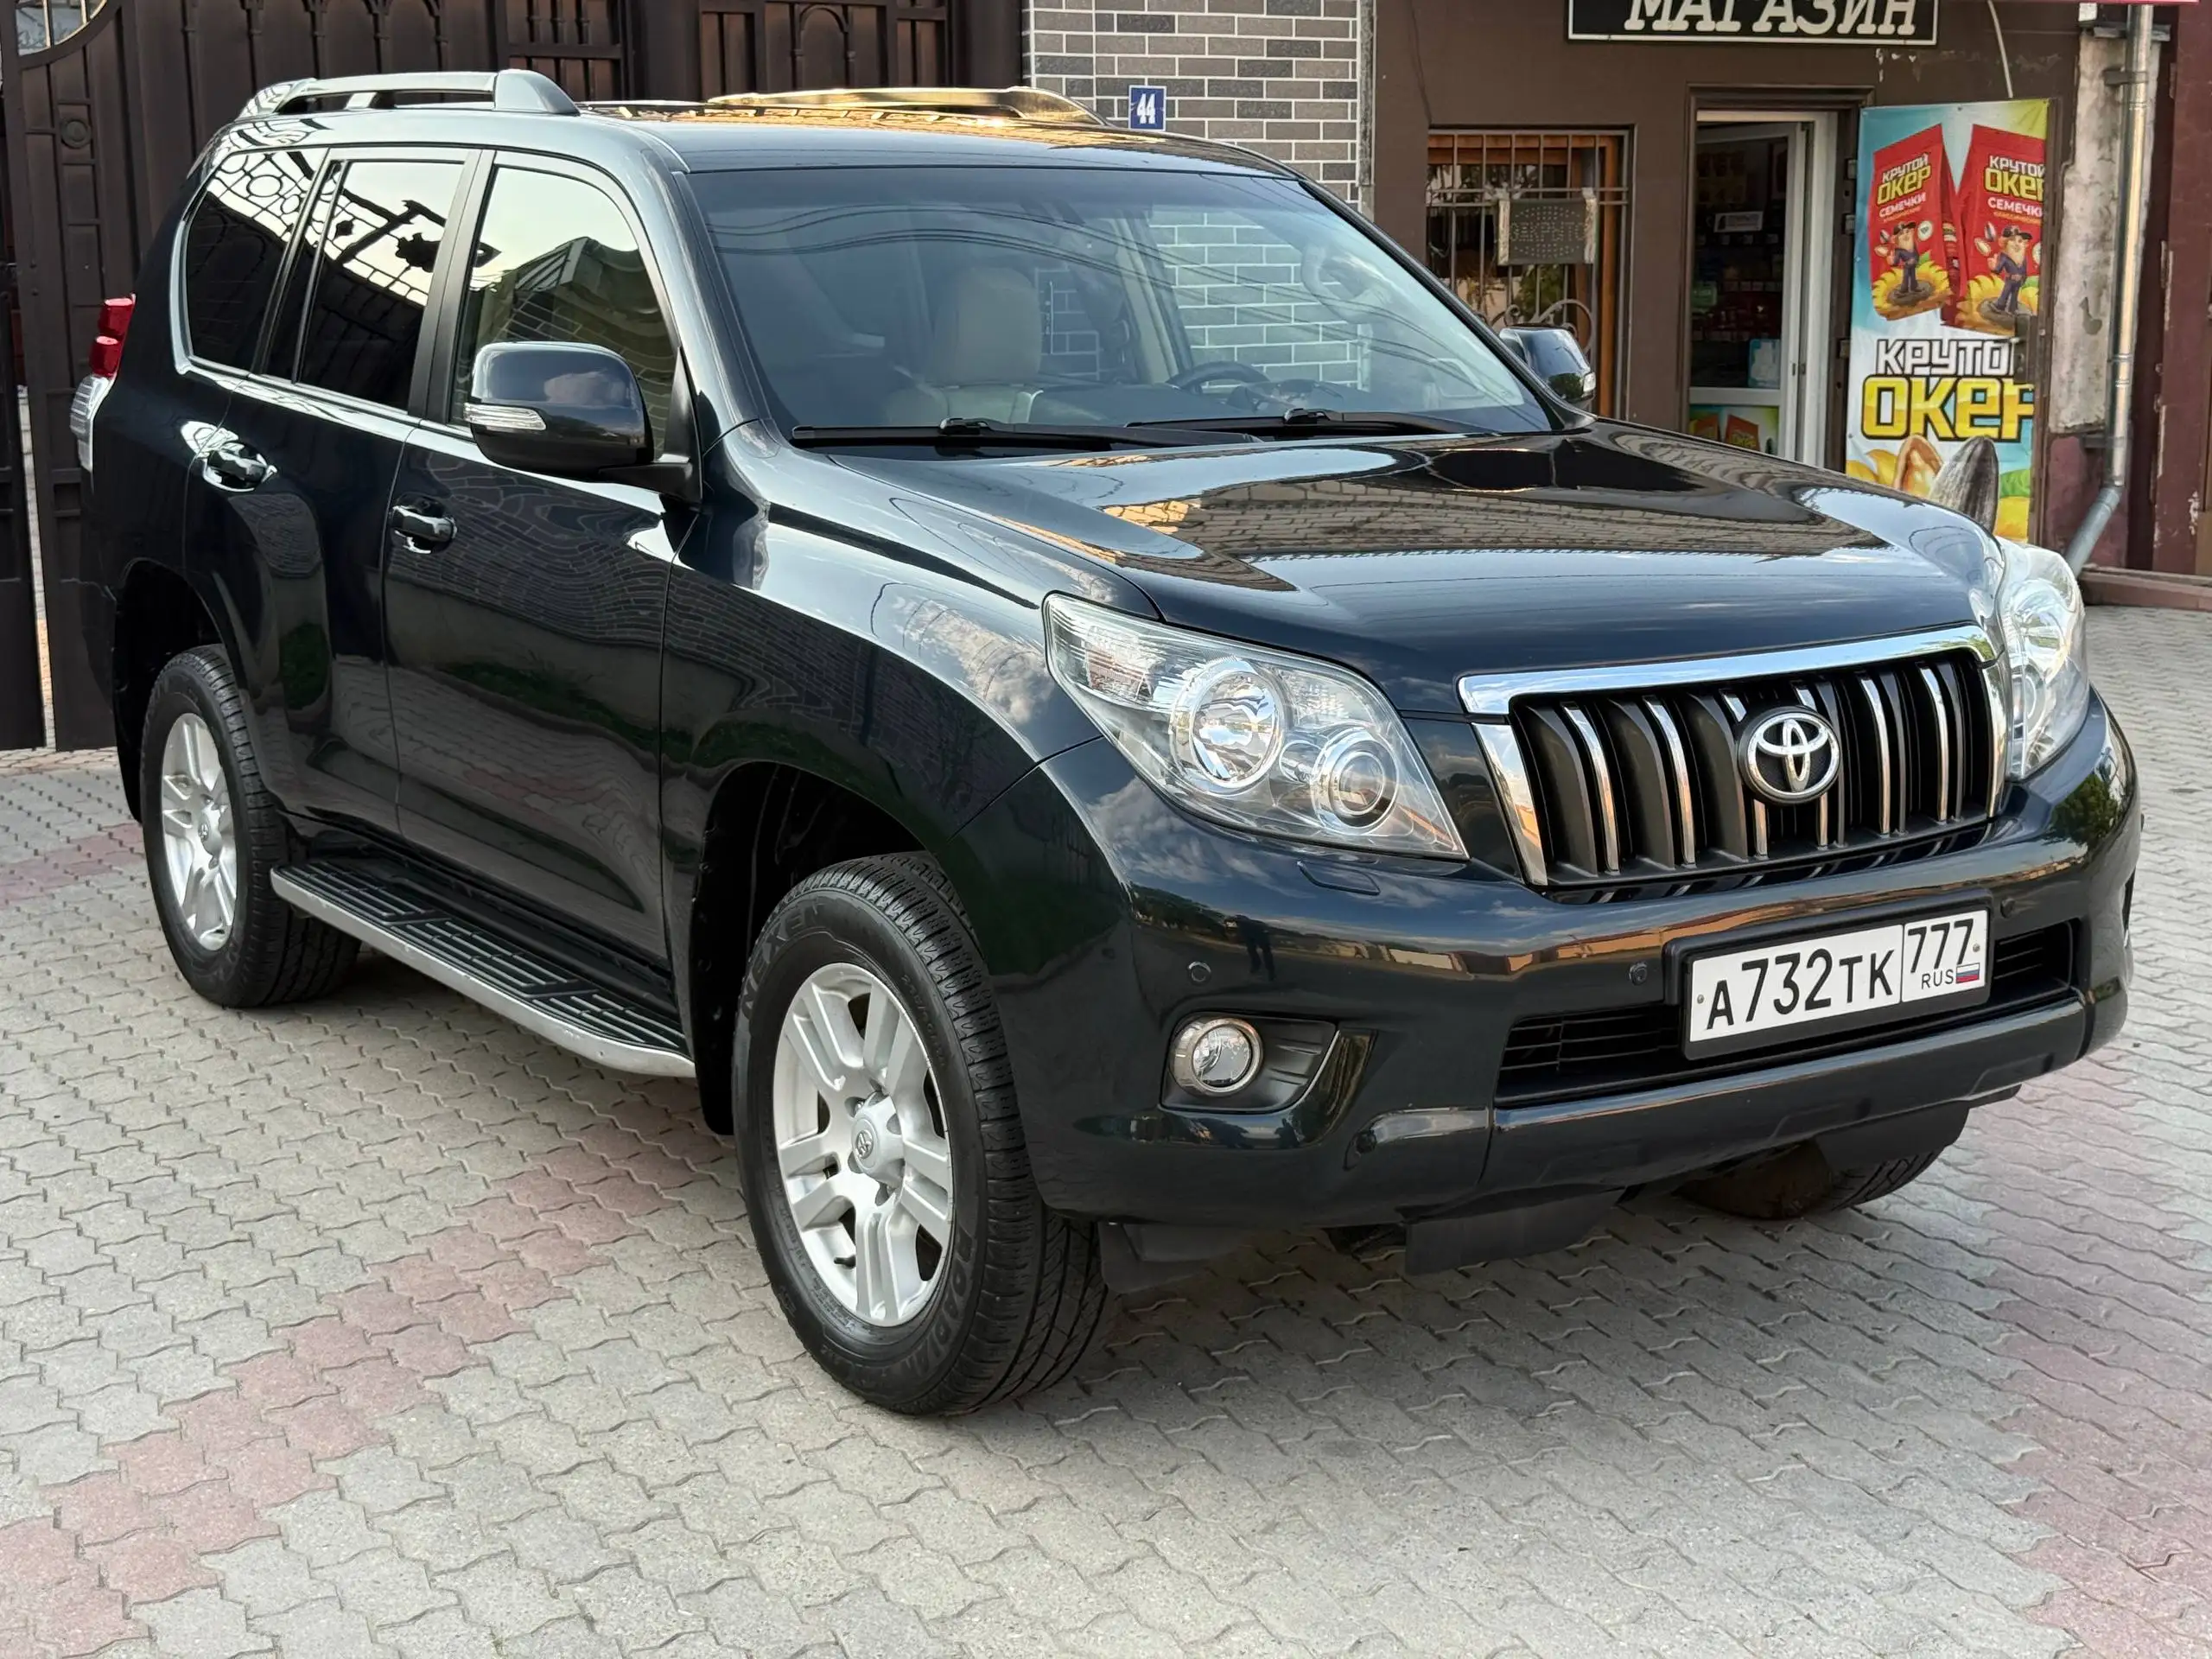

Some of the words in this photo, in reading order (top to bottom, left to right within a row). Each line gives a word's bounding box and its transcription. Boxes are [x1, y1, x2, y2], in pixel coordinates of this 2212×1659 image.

[1137, 93, 1156, 124] 44
[1877, 339, 2015, 376] КРУТО
[1706, 948, 1895, 1030] А732ТК
[1907, 918, 1974, 974] 777
[1922, 969, 1954, 989] RUS
